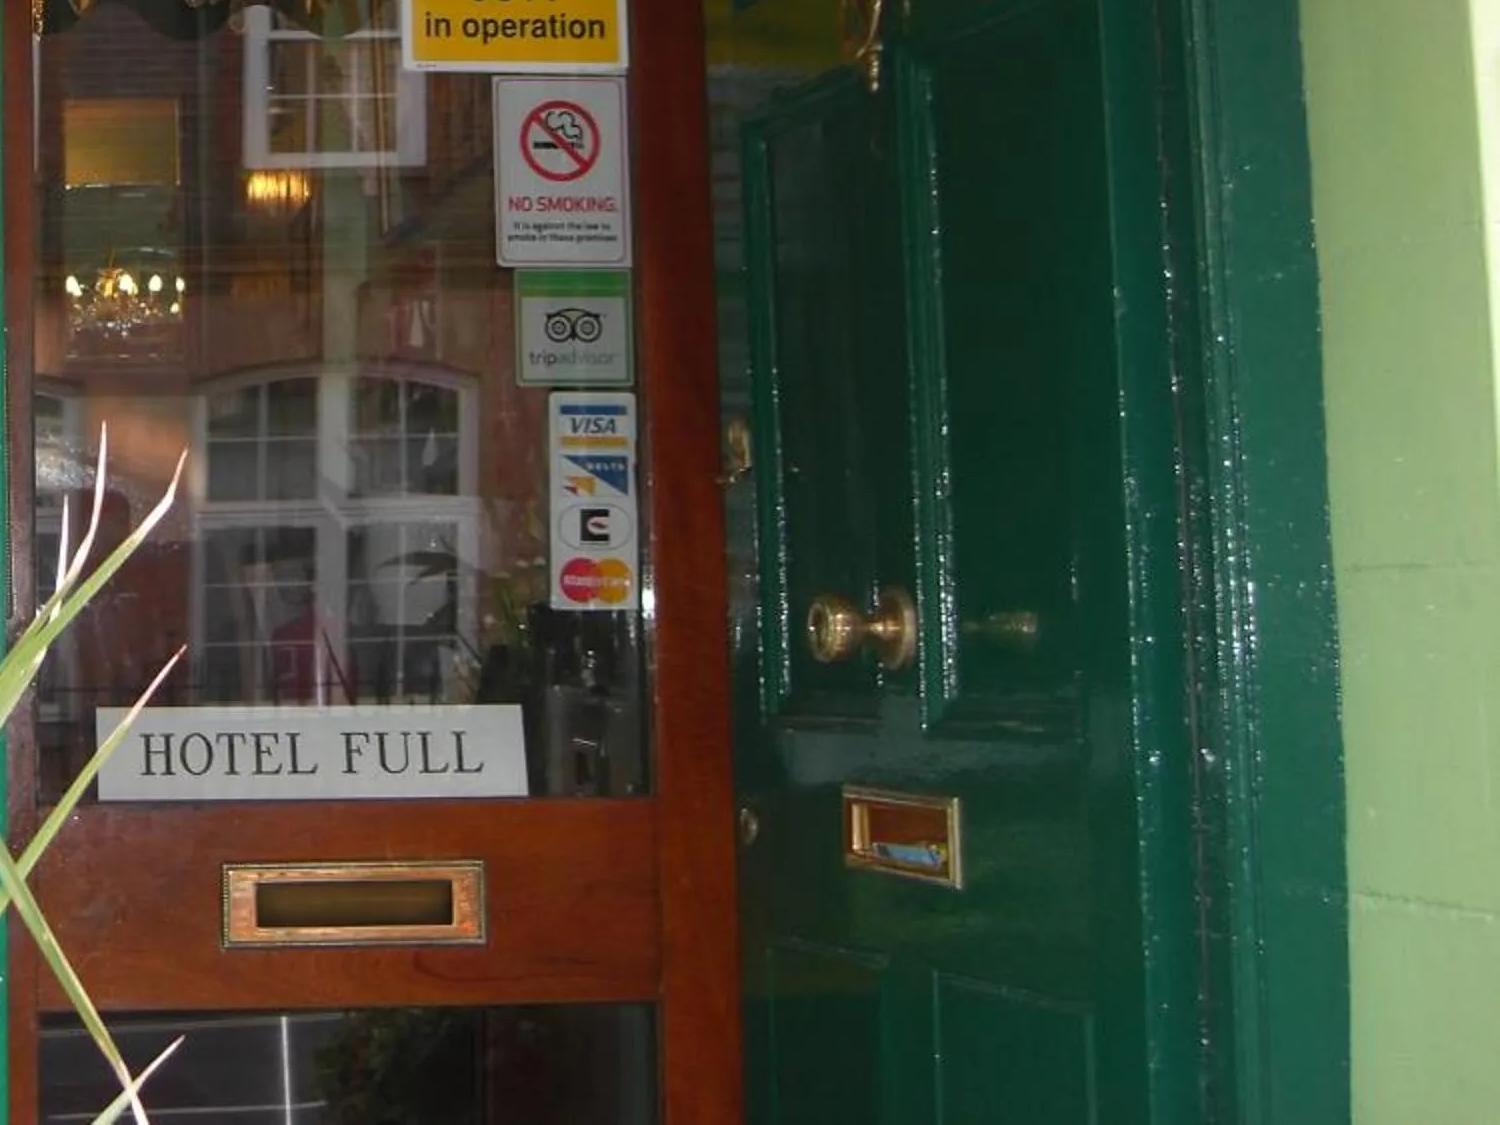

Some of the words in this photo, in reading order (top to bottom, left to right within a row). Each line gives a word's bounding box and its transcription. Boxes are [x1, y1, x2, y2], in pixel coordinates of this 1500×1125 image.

[425, 11, 452, 37] in
[462, 13, 606, 44] operation
[508, 196, 533, 212] NO
[569, 417, 617, 434] VISA
[140, 732, 319, 776] HOTEL
[340, 731, 486, 775] FULL
